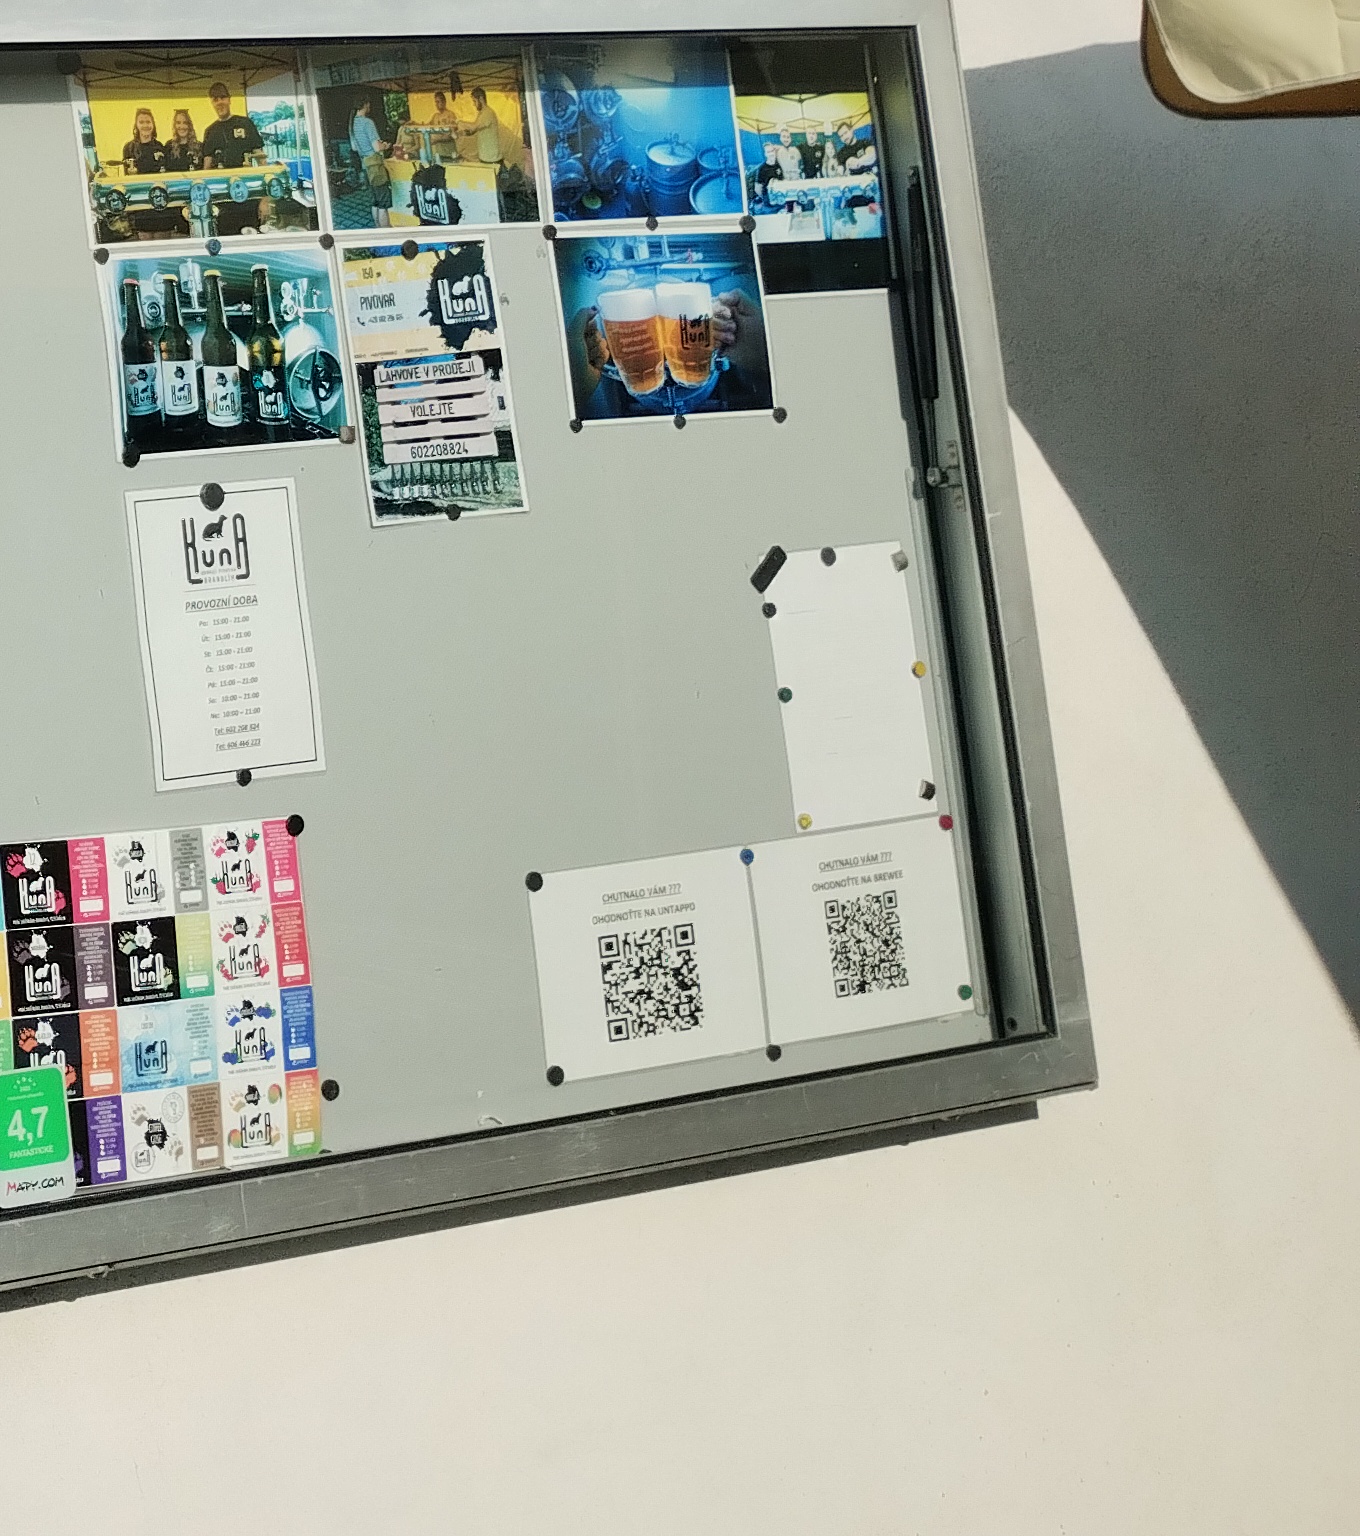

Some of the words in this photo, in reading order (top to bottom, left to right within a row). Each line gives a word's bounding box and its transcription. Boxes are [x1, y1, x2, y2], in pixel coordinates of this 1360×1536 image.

[360, 292, 396, 311] PIVOVAR
[423, 366, 430, 378] V
[432, 361, 475, 377] PRODEJI
[410, 402, 455, 417] VOLEJTE
[410, 442, 469, 459] 602208824
[185, 595, 231, 610] PROVOZNÍ
[233, 595, 258, 606] DOBA
[819, 857, 859, 870] CHUTNALO
[860, 853, 878, 863] VÁM
[602, 889, 645, 902] CHUTNALO
[647, 885, 666, 896] VÁM
[669, 883, 681, 893] ???
[812, 876, 859, 892] OHODNOŤTE
[861, 876, 872, 884] NA
[592, 909, 642, 925] OHODNOŤTE
[644, 909, 656, 917] NA
[658, 902, 696, 915] UNTAPPD
[7, 1106, 49, 1146] 4,7
